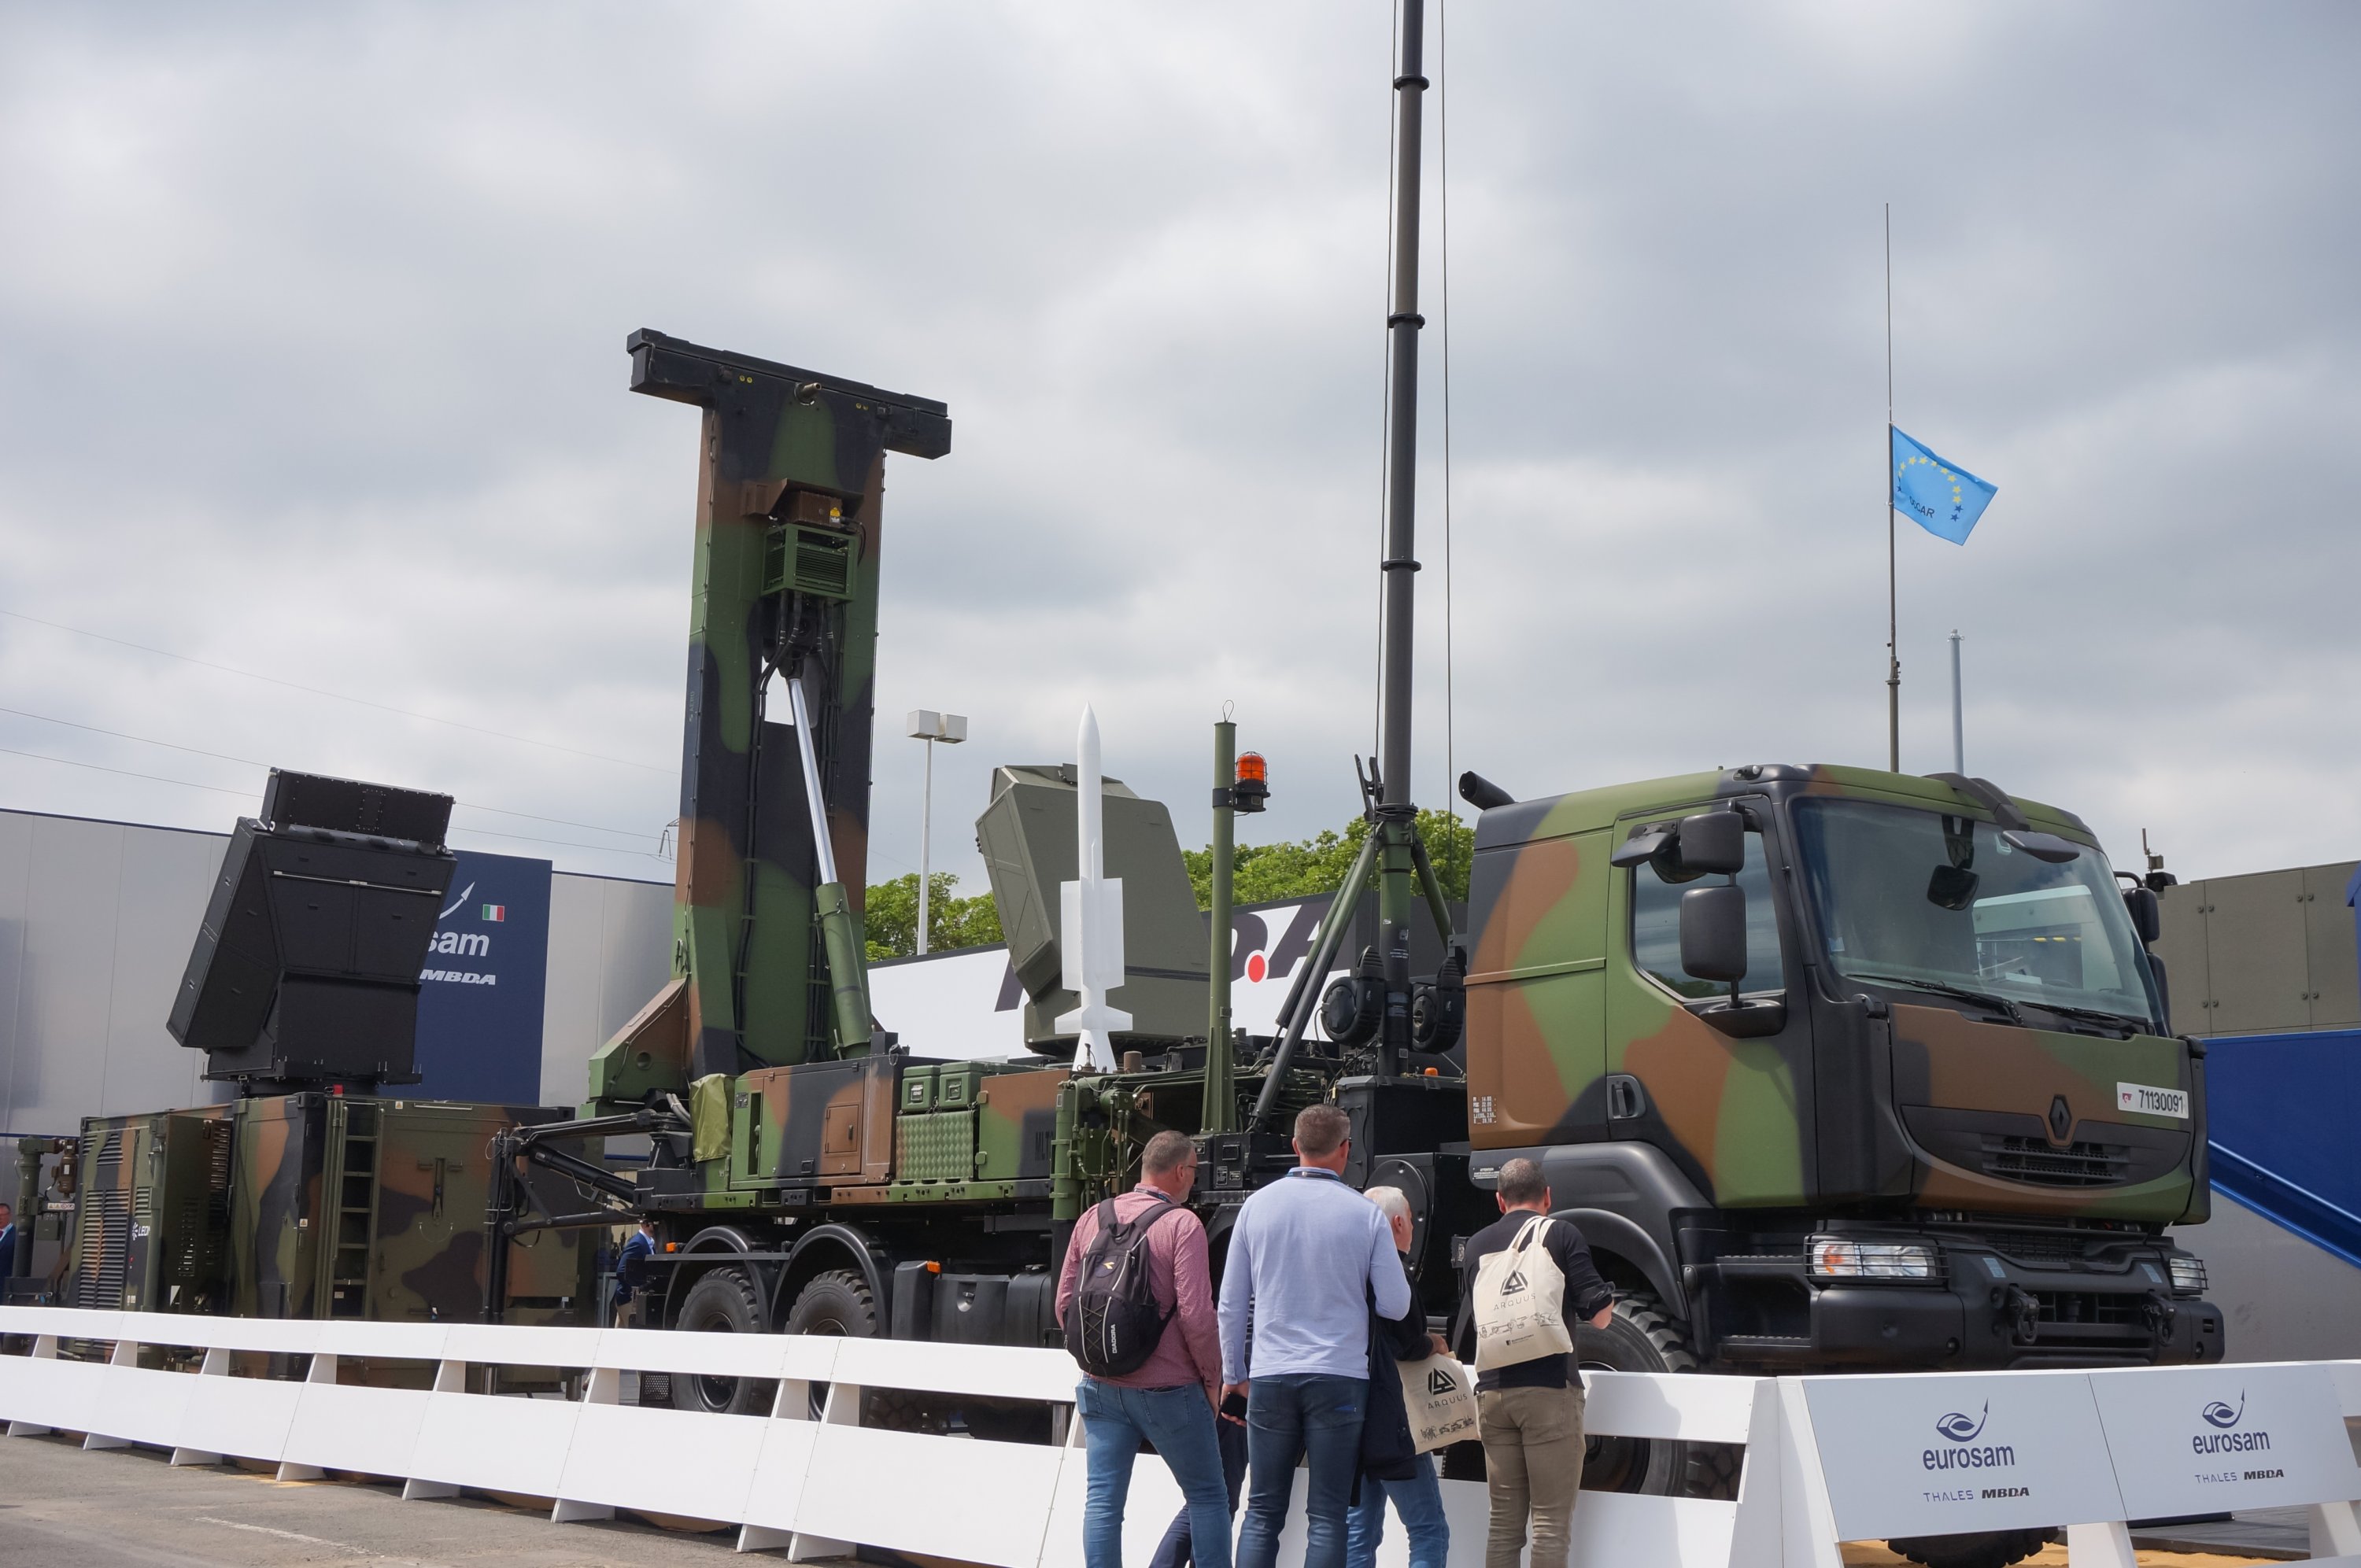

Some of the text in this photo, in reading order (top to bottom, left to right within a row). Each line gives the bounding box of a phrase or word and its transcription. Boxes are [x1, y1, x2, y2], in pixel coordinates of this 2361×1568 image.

[419, 968, 496, 985] MBDA
[2138, 1089, 2183, 1114] 71130091
[1494, 1293, 1536, 1311] ARQUUS
[1428, 1393, 1468, 1410] ARQUUS
[2193, 1431, 2270, 1455] eurosam
[1923, 1445, 2015, 1470] eurosam
[2195, 1469, 2285, 1484] THALES MBDA
[1923, 1487, 2030, 1503] THALES MBDA
